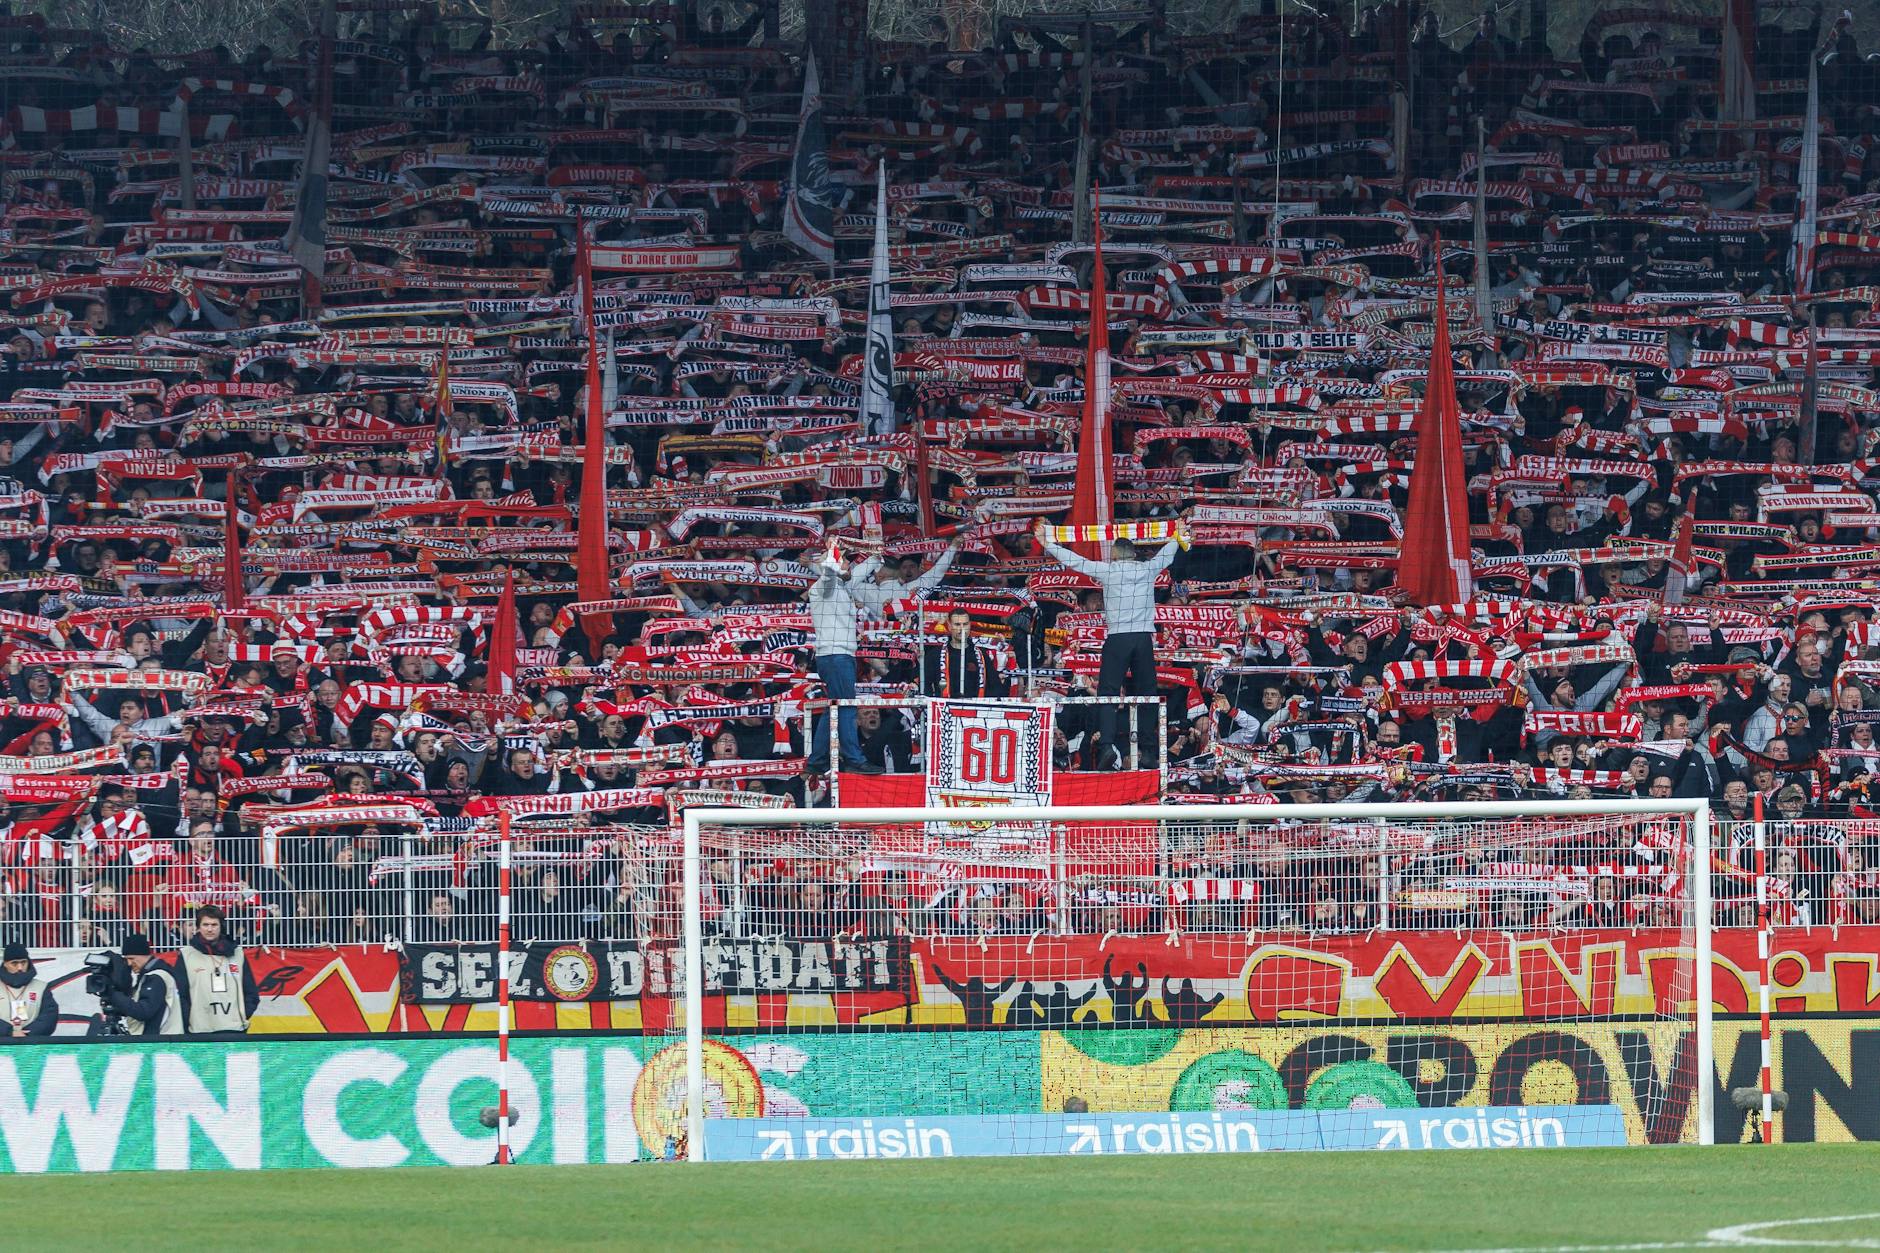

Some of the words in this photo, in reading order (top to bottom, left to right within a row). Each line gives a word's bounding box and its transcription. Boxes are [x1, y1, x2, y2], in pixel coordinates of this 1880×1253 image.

[569, 170, 634, 181] UNIONER
[621, 254, 634, 265] 60
[637, 254, 668, 265] JAHRE
[670, 254, 698, 265] UNION
[468, 301, 529, 311] DISTRIKT
[1029, 288, 1165, 313] UNON
[1311, 333, 1357, 347] SEITE
[1617, 328, 1667, 344] SEITE
[1699, 352, 1758, 364] UNION
[1196, 375, 1251, 388] Union
[452, 388, 487, 396] UNION
[733, 395, 791, 410] DISTRIKT
[625, 412, 668, 423] UNION
[192, 421, 293, 433] WALDSEITE
[726, 419, 767, 431] UNION
[317, 428, 336, 440] FC
[341, 428, 386, 441] Union
[391, 427, 436, 441] Berlin
[830, 467, 863, 487] UNION
[337, 493, 370, 503] UNION
[261, 504, 290, 521] ALTE
[728, 513, 762, 522] UNION
[1261, 514, 1292, 522] UNION
[331, 518, 411, 535] SYNDIKAT
[1346, 539, 1383, 547] BERLIN
[344, 565, 420, 577] SYNDIKAT
[348, 582, 391, 591] UNION
[737, 573, 809, 588] SYNDIKAT
[645, 598, 679, 609] UNION
[391, 623, 454, 641] EISERN
[766, 632, 807, 651] WALD
[646, 669, 698, 681] UNION
[466, 692, 522, 705] UNION
[1401, 691, 1453, 702] EISERN
[1459, 690, 1504, 701] UNION
[432, 703, 520, 714] BERLIN
[664, 707, 688, 722] FC
[961, 725, 1018, 784] 60
[637, 770, 664, 784] WO
[668, 769, 688, 782] DU
[691, 766, 733, 779] AUCH
[743, 761, 807, 777] SPIELST
[15, 779, 56, 788] Eisern
[61, 777, 90, 789] 1422
[209, 1002, 231, 1015] TV
[0, 1052, 262, 1173] WN
[1112, 1112, 1261, 1154] raisin
[1419, 1107, 1566, 1150] raisin
[806, 1119, 953, 1158] raisin
